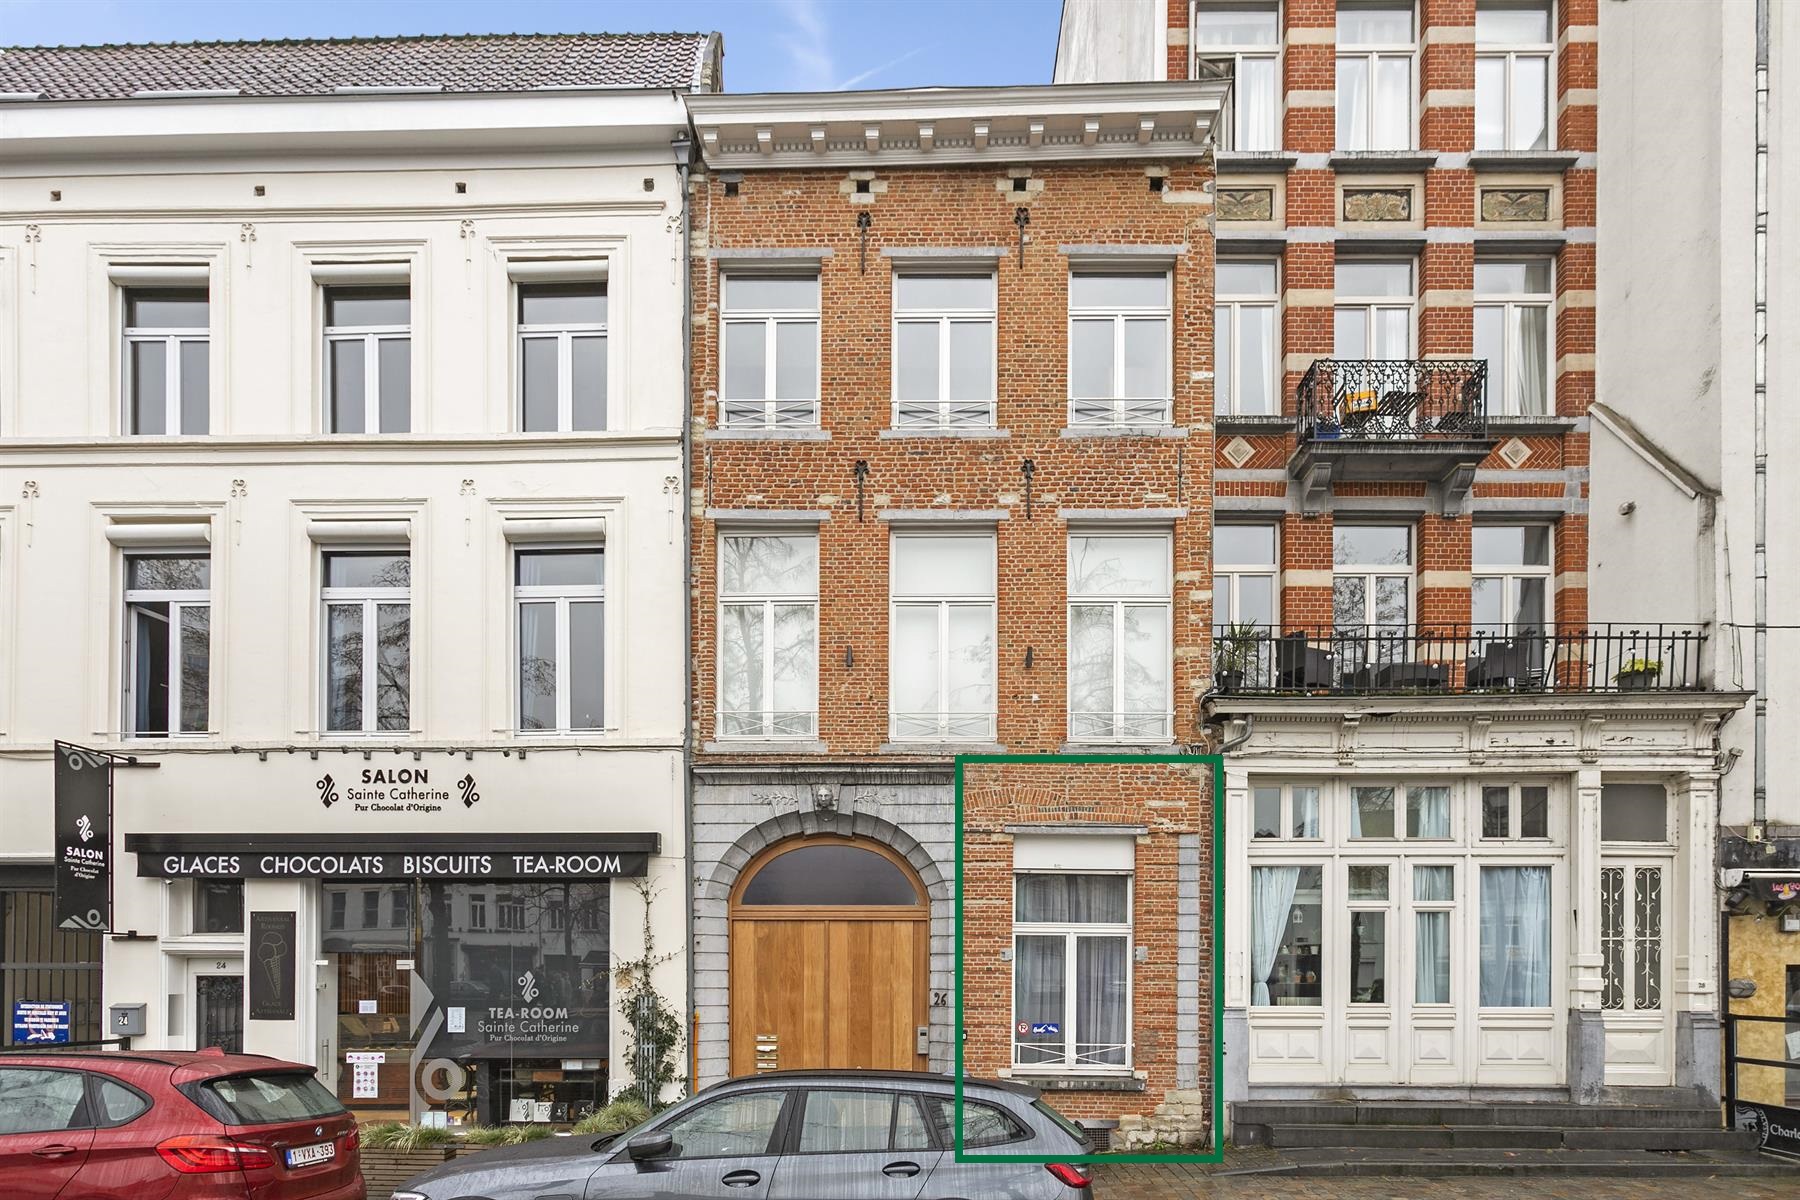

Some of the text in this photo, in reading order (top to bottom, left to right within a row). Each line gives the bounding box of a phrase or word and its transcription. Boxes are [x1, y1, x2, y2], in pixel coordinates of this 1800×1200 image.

[361, 769, 428, 784] SALON
[347, 787, 449, 800] Sainte Catherine
[371, 803, 403, 812] Chocolat
[406, 803, 441, 813] d'Origine
[66, 846, 103, 860] SALON
[81, 859, 105, 867] Catherine
[163, 855, 622, 874] GLACES CHOCOLATS BISCUITS TEA-ROOM
[216, 961, 226, 969] 24
[934, 992, 947, 1006] 26
[488, 1007, 568, 1019] TEA-ROOM
[118, 1016, 128, 1025] 24
[477, 1019, 579, 1032] Sainte Catherine
[489, 1034, 567, 1044] Pur Chocolat d'Origine
[293, 1144, 334, 1162] 1-VXA-393
